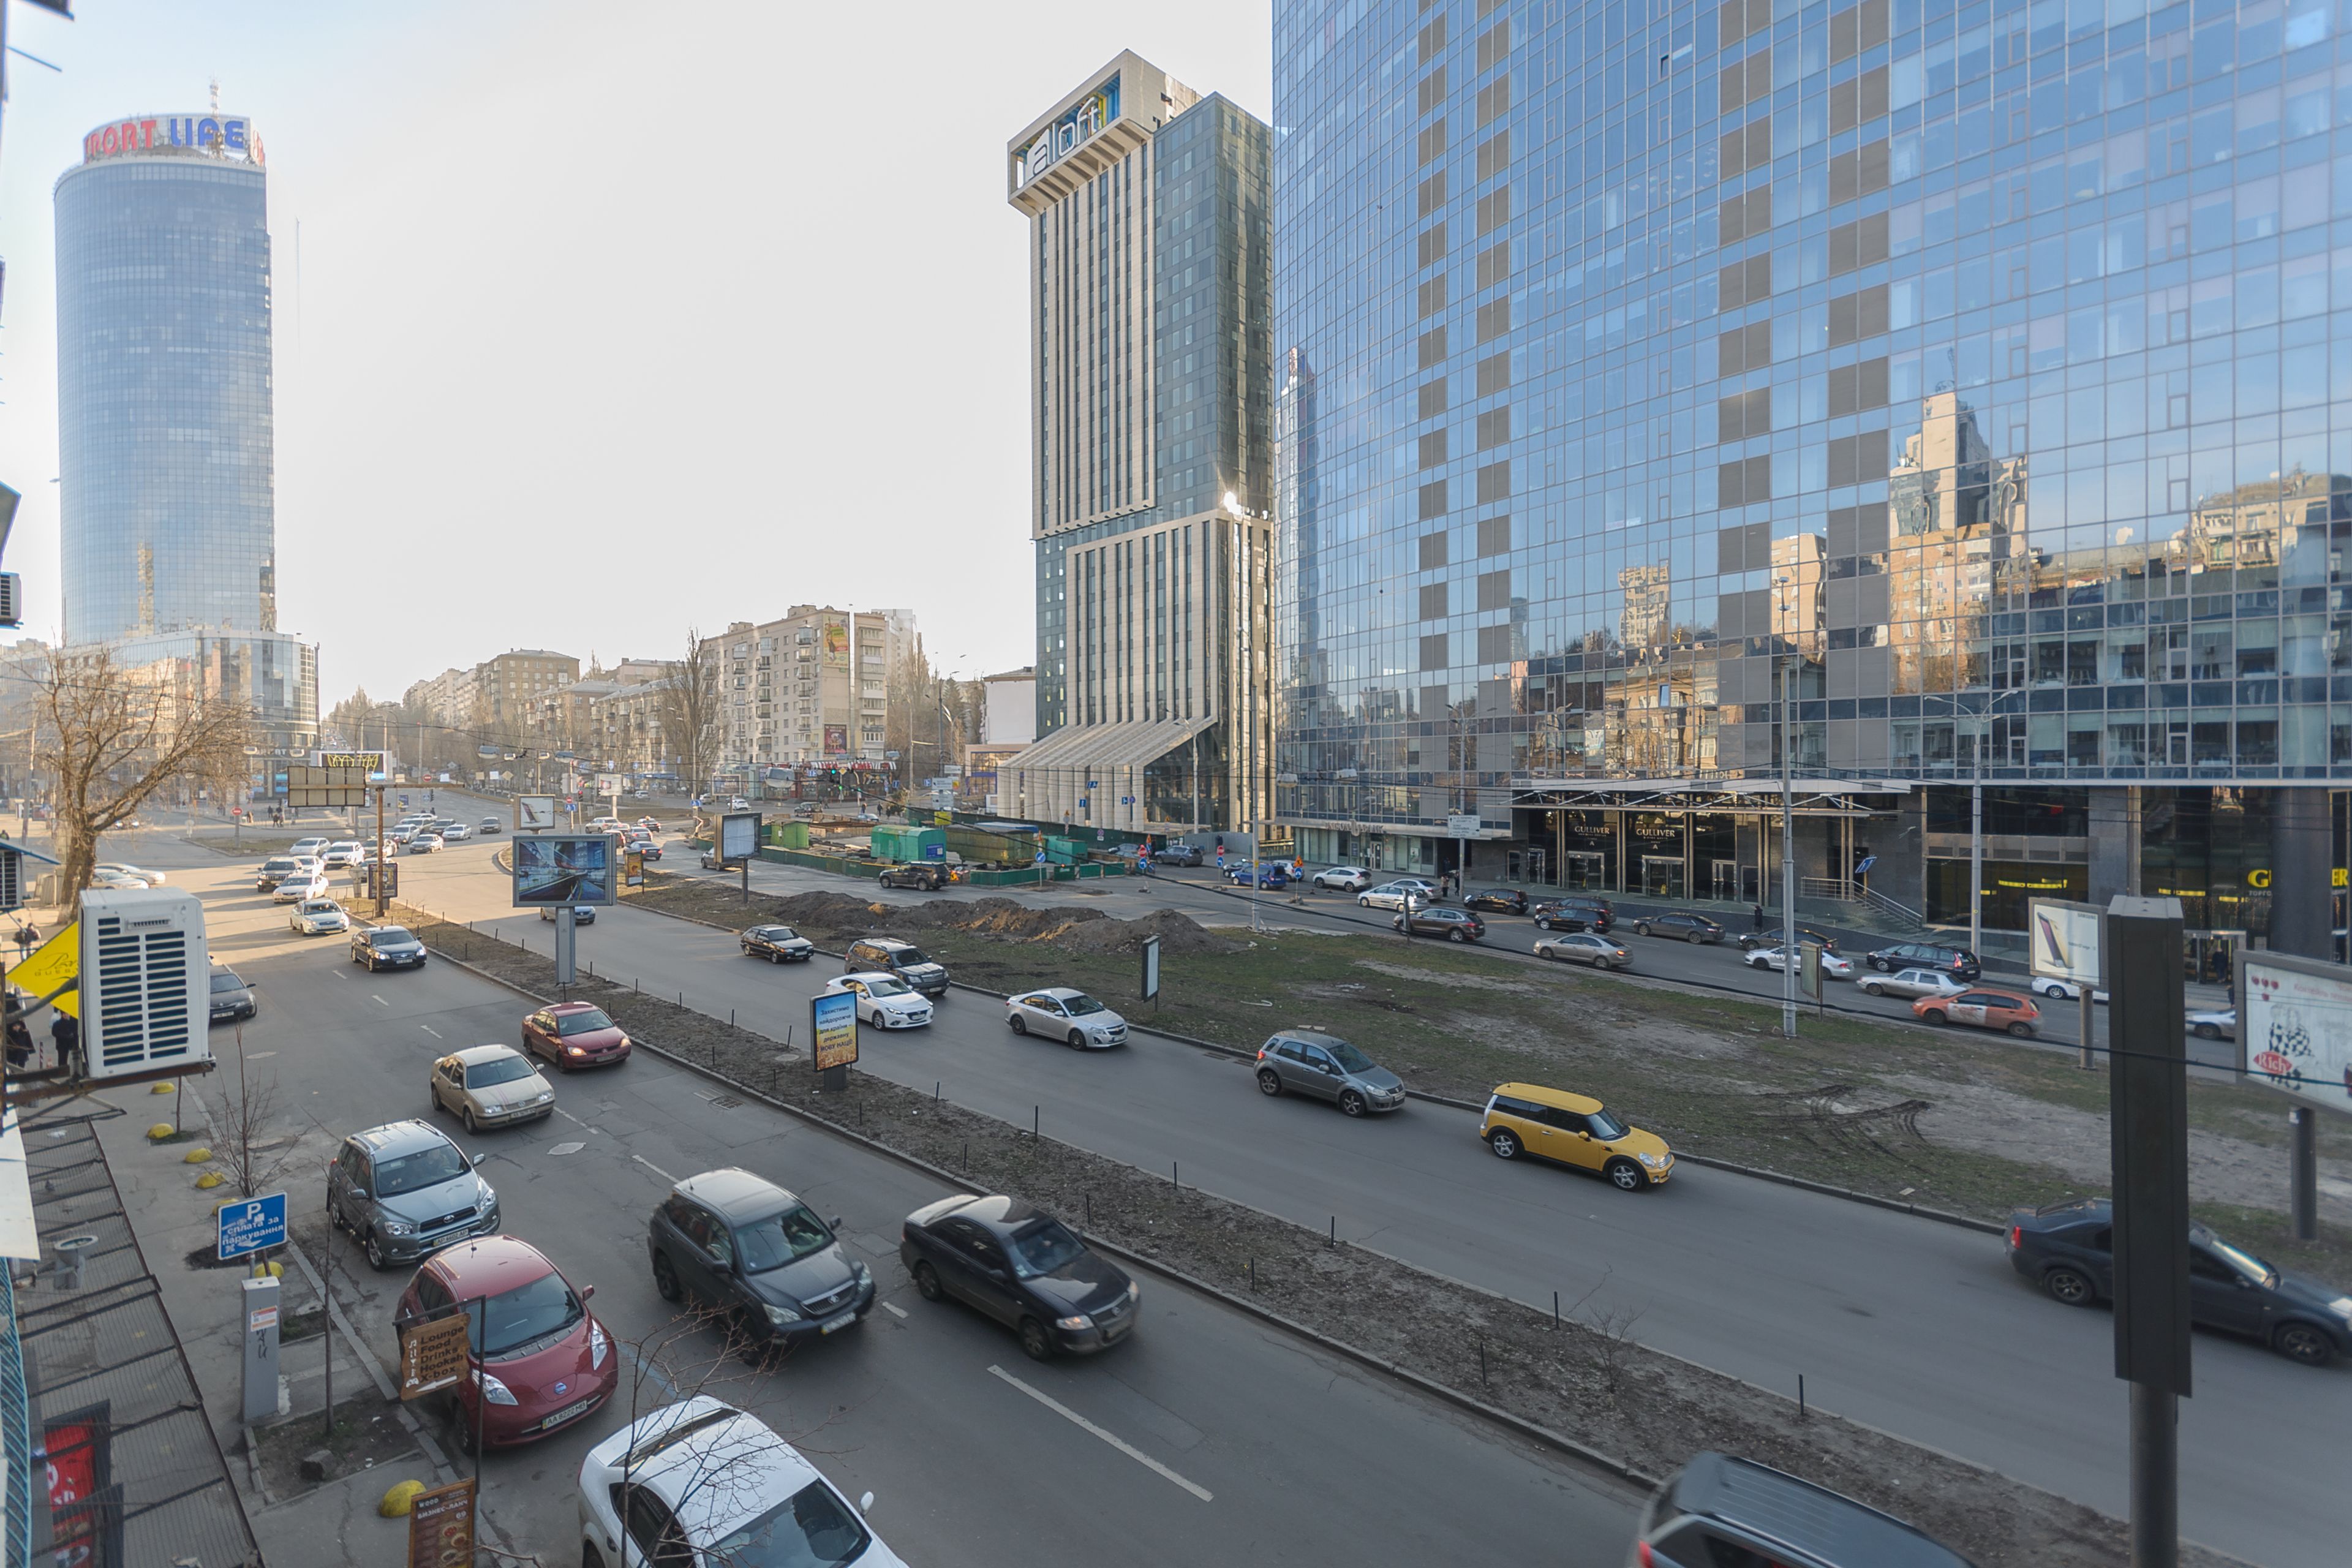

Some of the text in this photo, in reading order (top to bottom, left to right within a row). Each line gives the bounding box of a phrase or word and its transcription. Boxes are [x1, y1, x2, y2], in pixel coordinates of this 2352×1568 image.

[170, 118, 244, 149] LIFE
[1027, 97, 1099, 182] aloft
[1575, 826, 1610, 835] GULLIVER
[1636, 828, 1675, 837] GULLIVER
[821, 1006, 850, 1016] Захистимо
[819, 1014, 852, 1025] найдорожче
[823, 1032, 850, 1043] державну
[820, 1043, 835, 1052] МОВУ
[2258, 1053, 2287, 1072] Rich
[247, 1202, 262, 1221] P
[227, 1216, 280, 1235] сплата за
[222, 1224, 284, 1246] паркування
[421, 1326, 464, 1344] Lounge
[421, 1338, 451, 1354] Food
[421, 1346, 458, 1363] Drinks
[420, 1353, 463, 1373] Hookah
[421, 1366, 456, 1382] X-box
[418, 1498, 439, 1508] WOOD
[456, 1510, 467, 1519] 69
